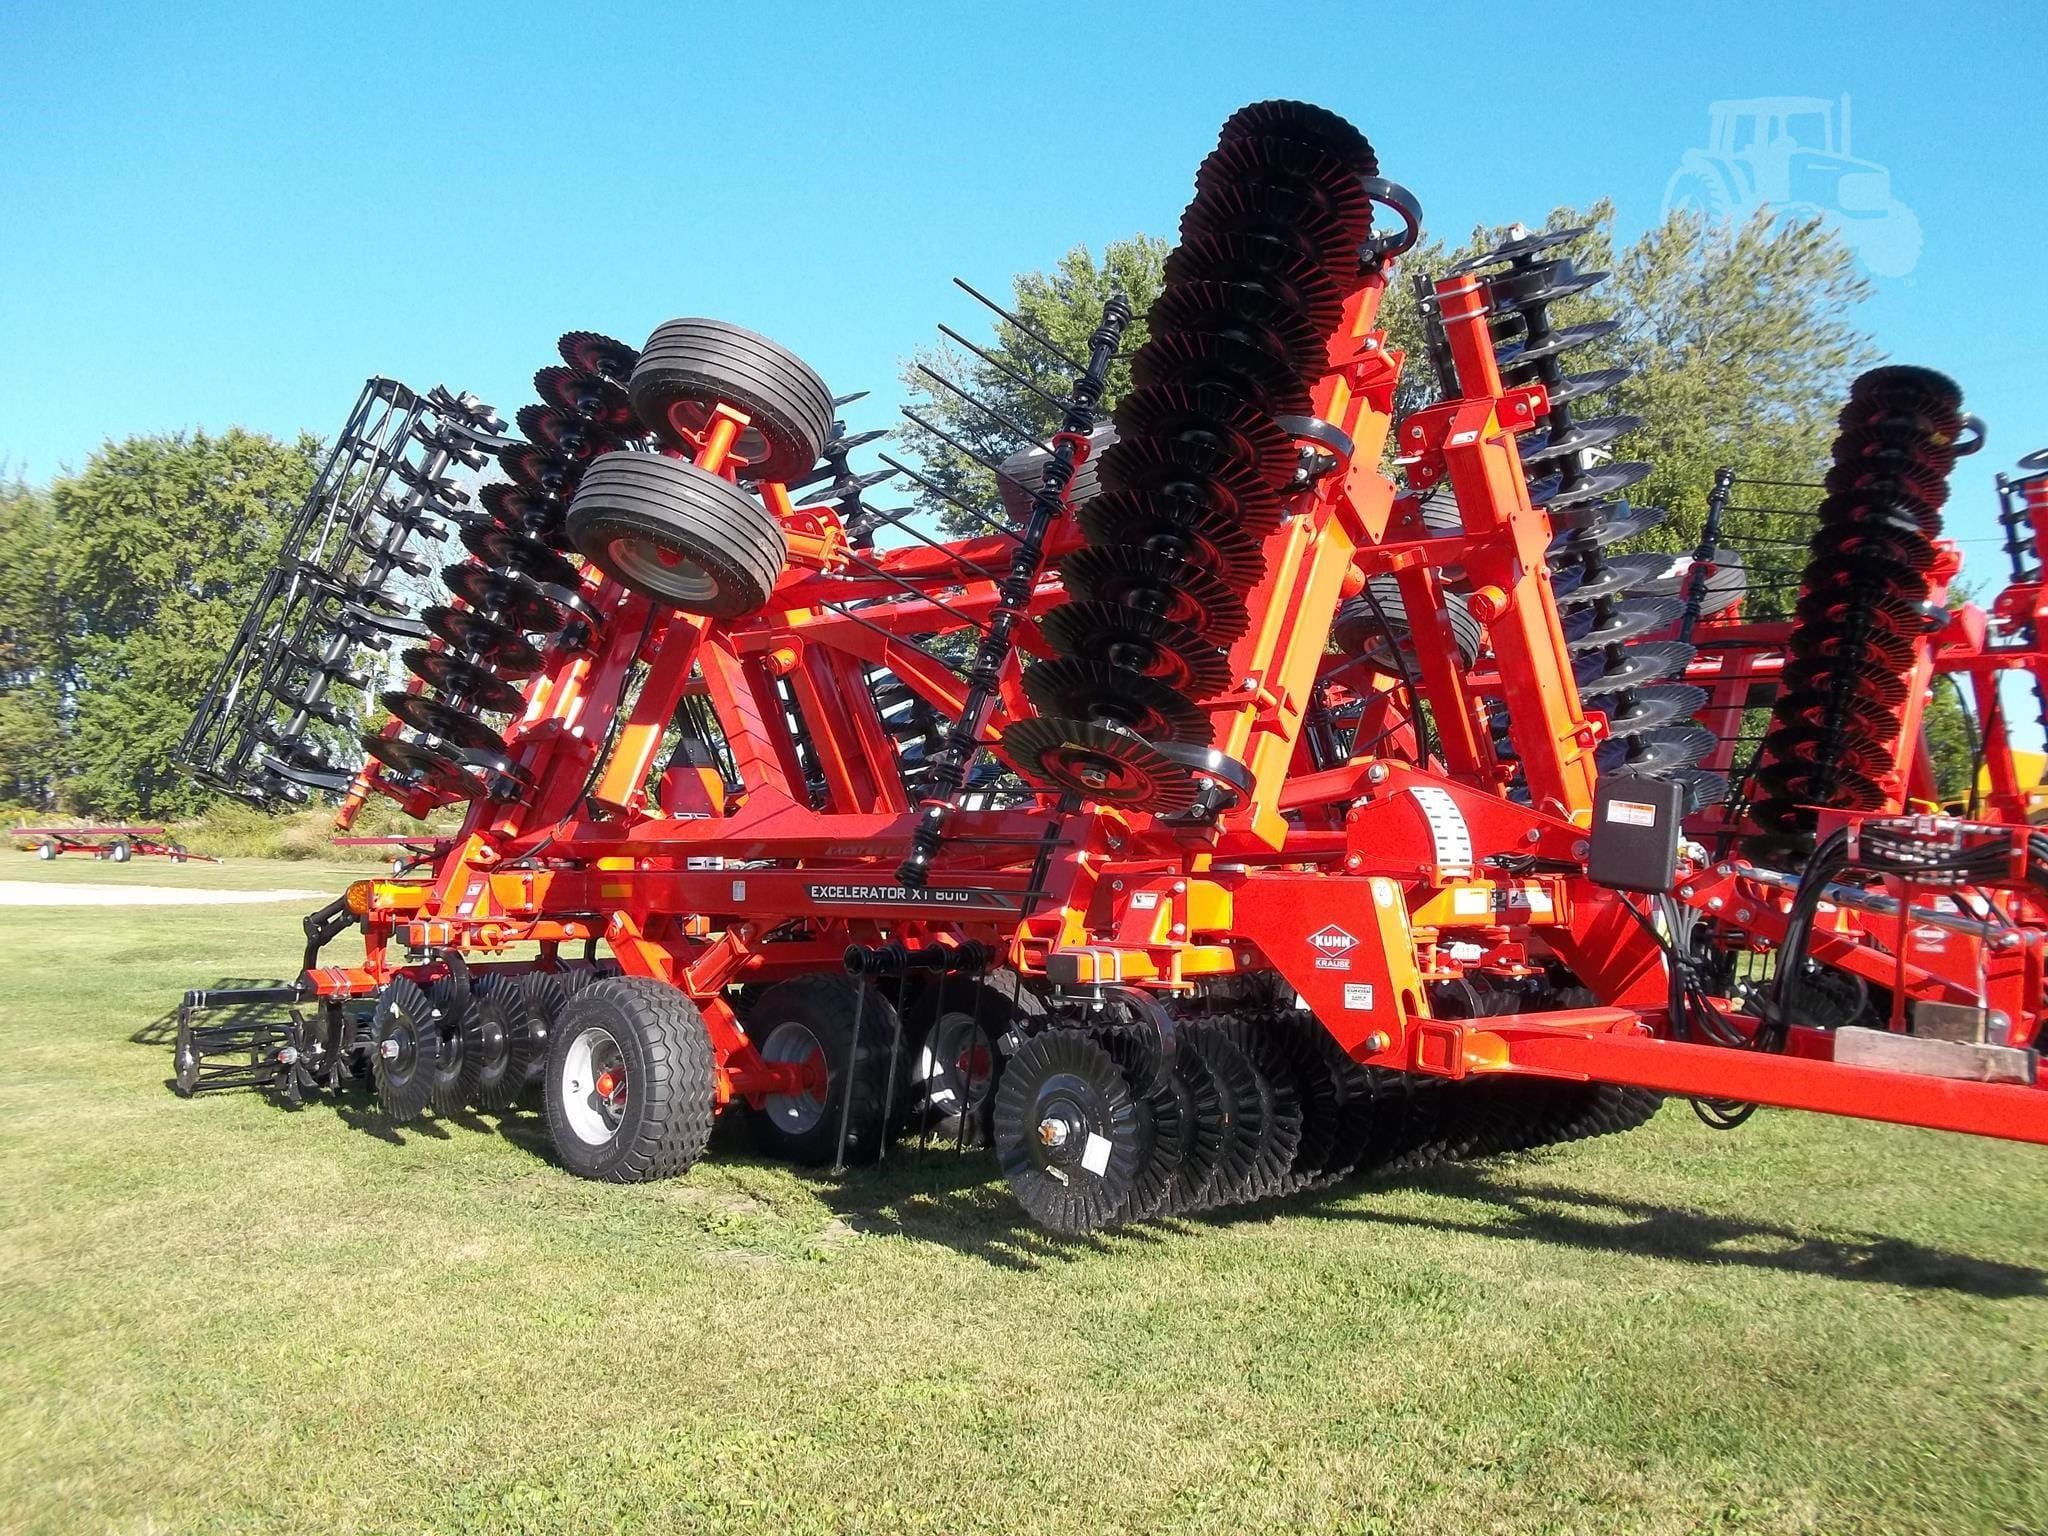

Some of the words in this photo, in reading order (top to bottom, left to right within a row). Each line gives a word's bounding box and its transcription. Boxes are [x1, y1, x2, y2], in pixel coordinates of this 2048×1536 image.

[811, 885, 906, 900] EXCELERATOR
[935, 890, 969, 901] 8010
[1315, 935, 1350, 947] KUHN
[1315, 959, 1351, 968] KRAUSE
